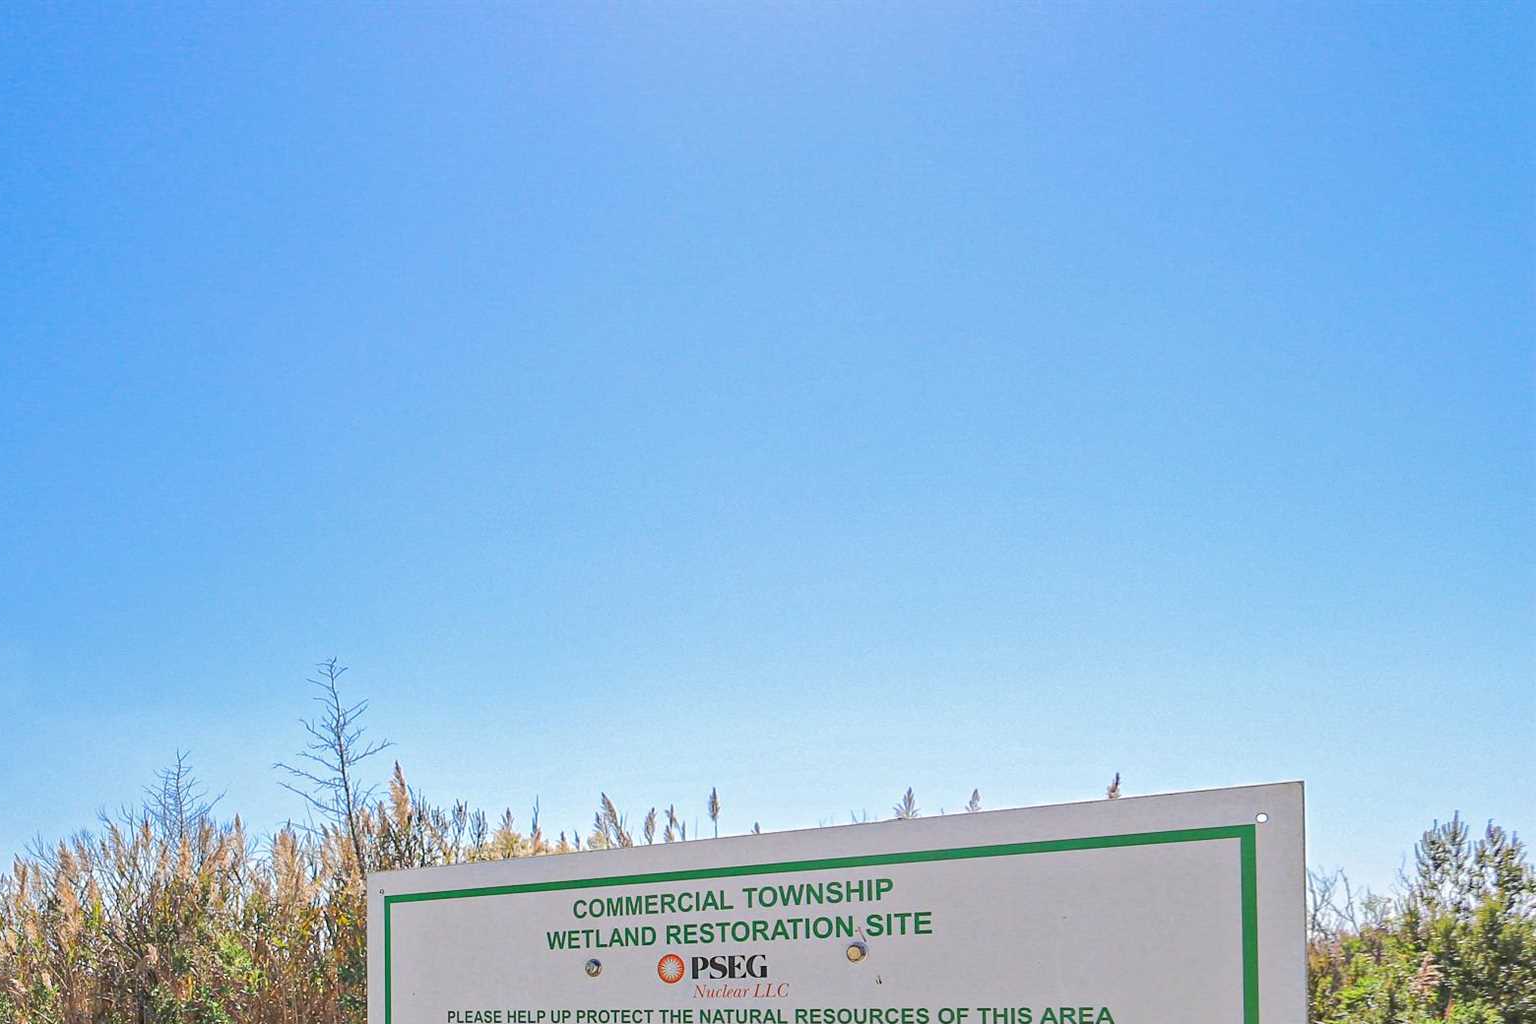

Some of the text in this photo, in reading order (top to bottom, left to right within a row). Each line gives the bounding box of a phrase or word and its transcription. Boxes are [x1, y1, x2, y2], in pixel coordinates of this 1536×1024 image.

[573, 878, 893, 919] COMMERCIAL TOWNSHIP
[546, 912, 933, 950] WETLAND RESTORATION SITE
[691, 954, 768, 980] PSEG
[693, 983, 789, 999] Nuclear LLC
[448, 1007, 1115, 1024] PLEASE HELP UP PROTECT THE NATURAL RESOURCES OF THIS AREA
